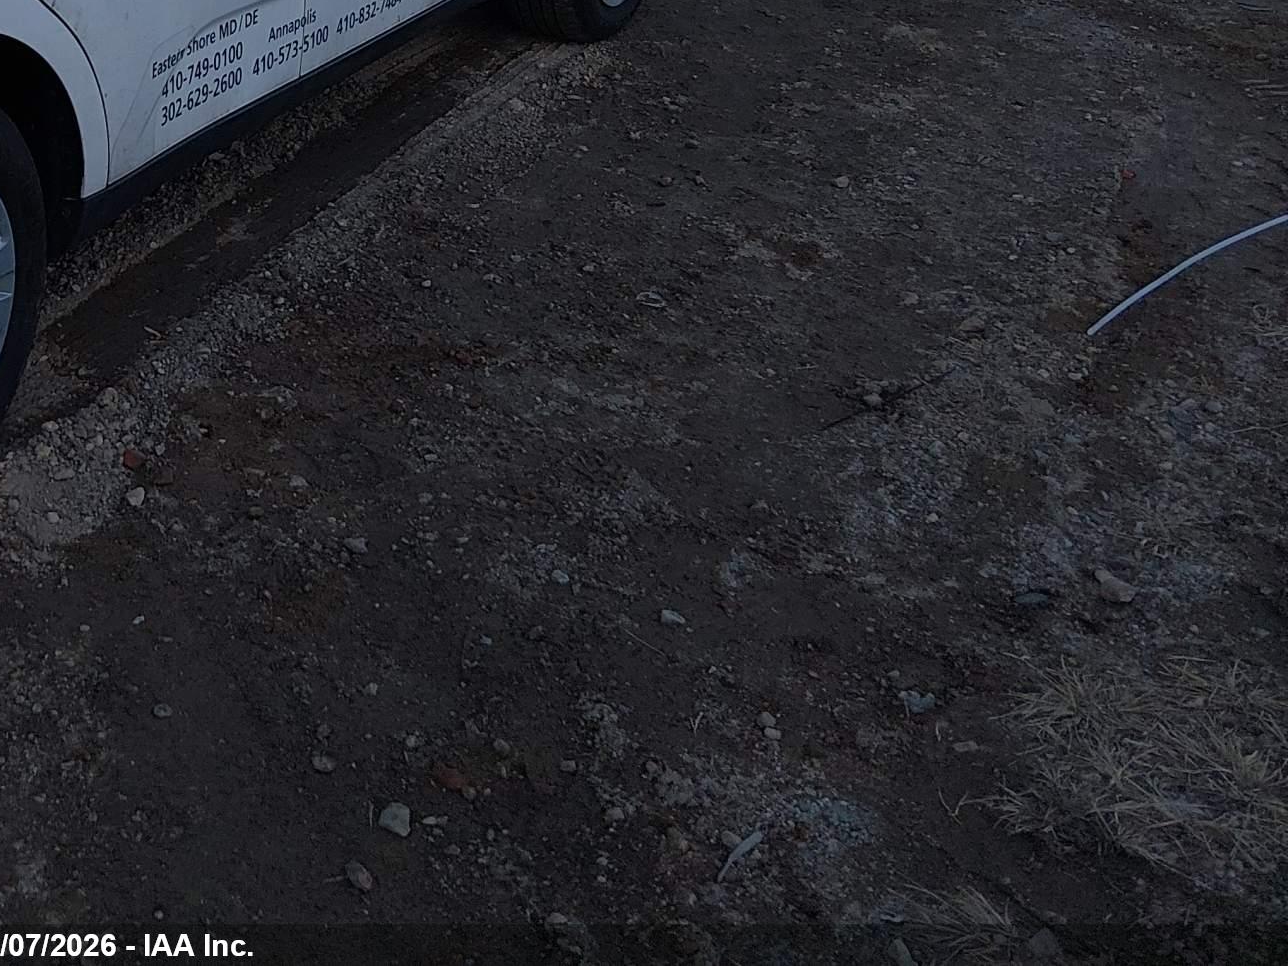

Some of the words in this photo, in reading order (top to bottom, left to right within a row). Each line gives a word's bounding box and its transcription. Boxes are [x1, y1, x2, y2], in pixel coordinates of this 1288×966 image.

[151, 48, 186, 80] Eastern
[187, 31, 216, 57] Shore
[218, 19, 238, 41] MD
[245, 8, 260, 29] DE
[252, 25, 329, 76] 410-573-5100
[268, 8, 317, 43] Annapolis
[161, 41, 244, 99] 410-749-0100
[161, 67, 243, 127] 302-629-2600
